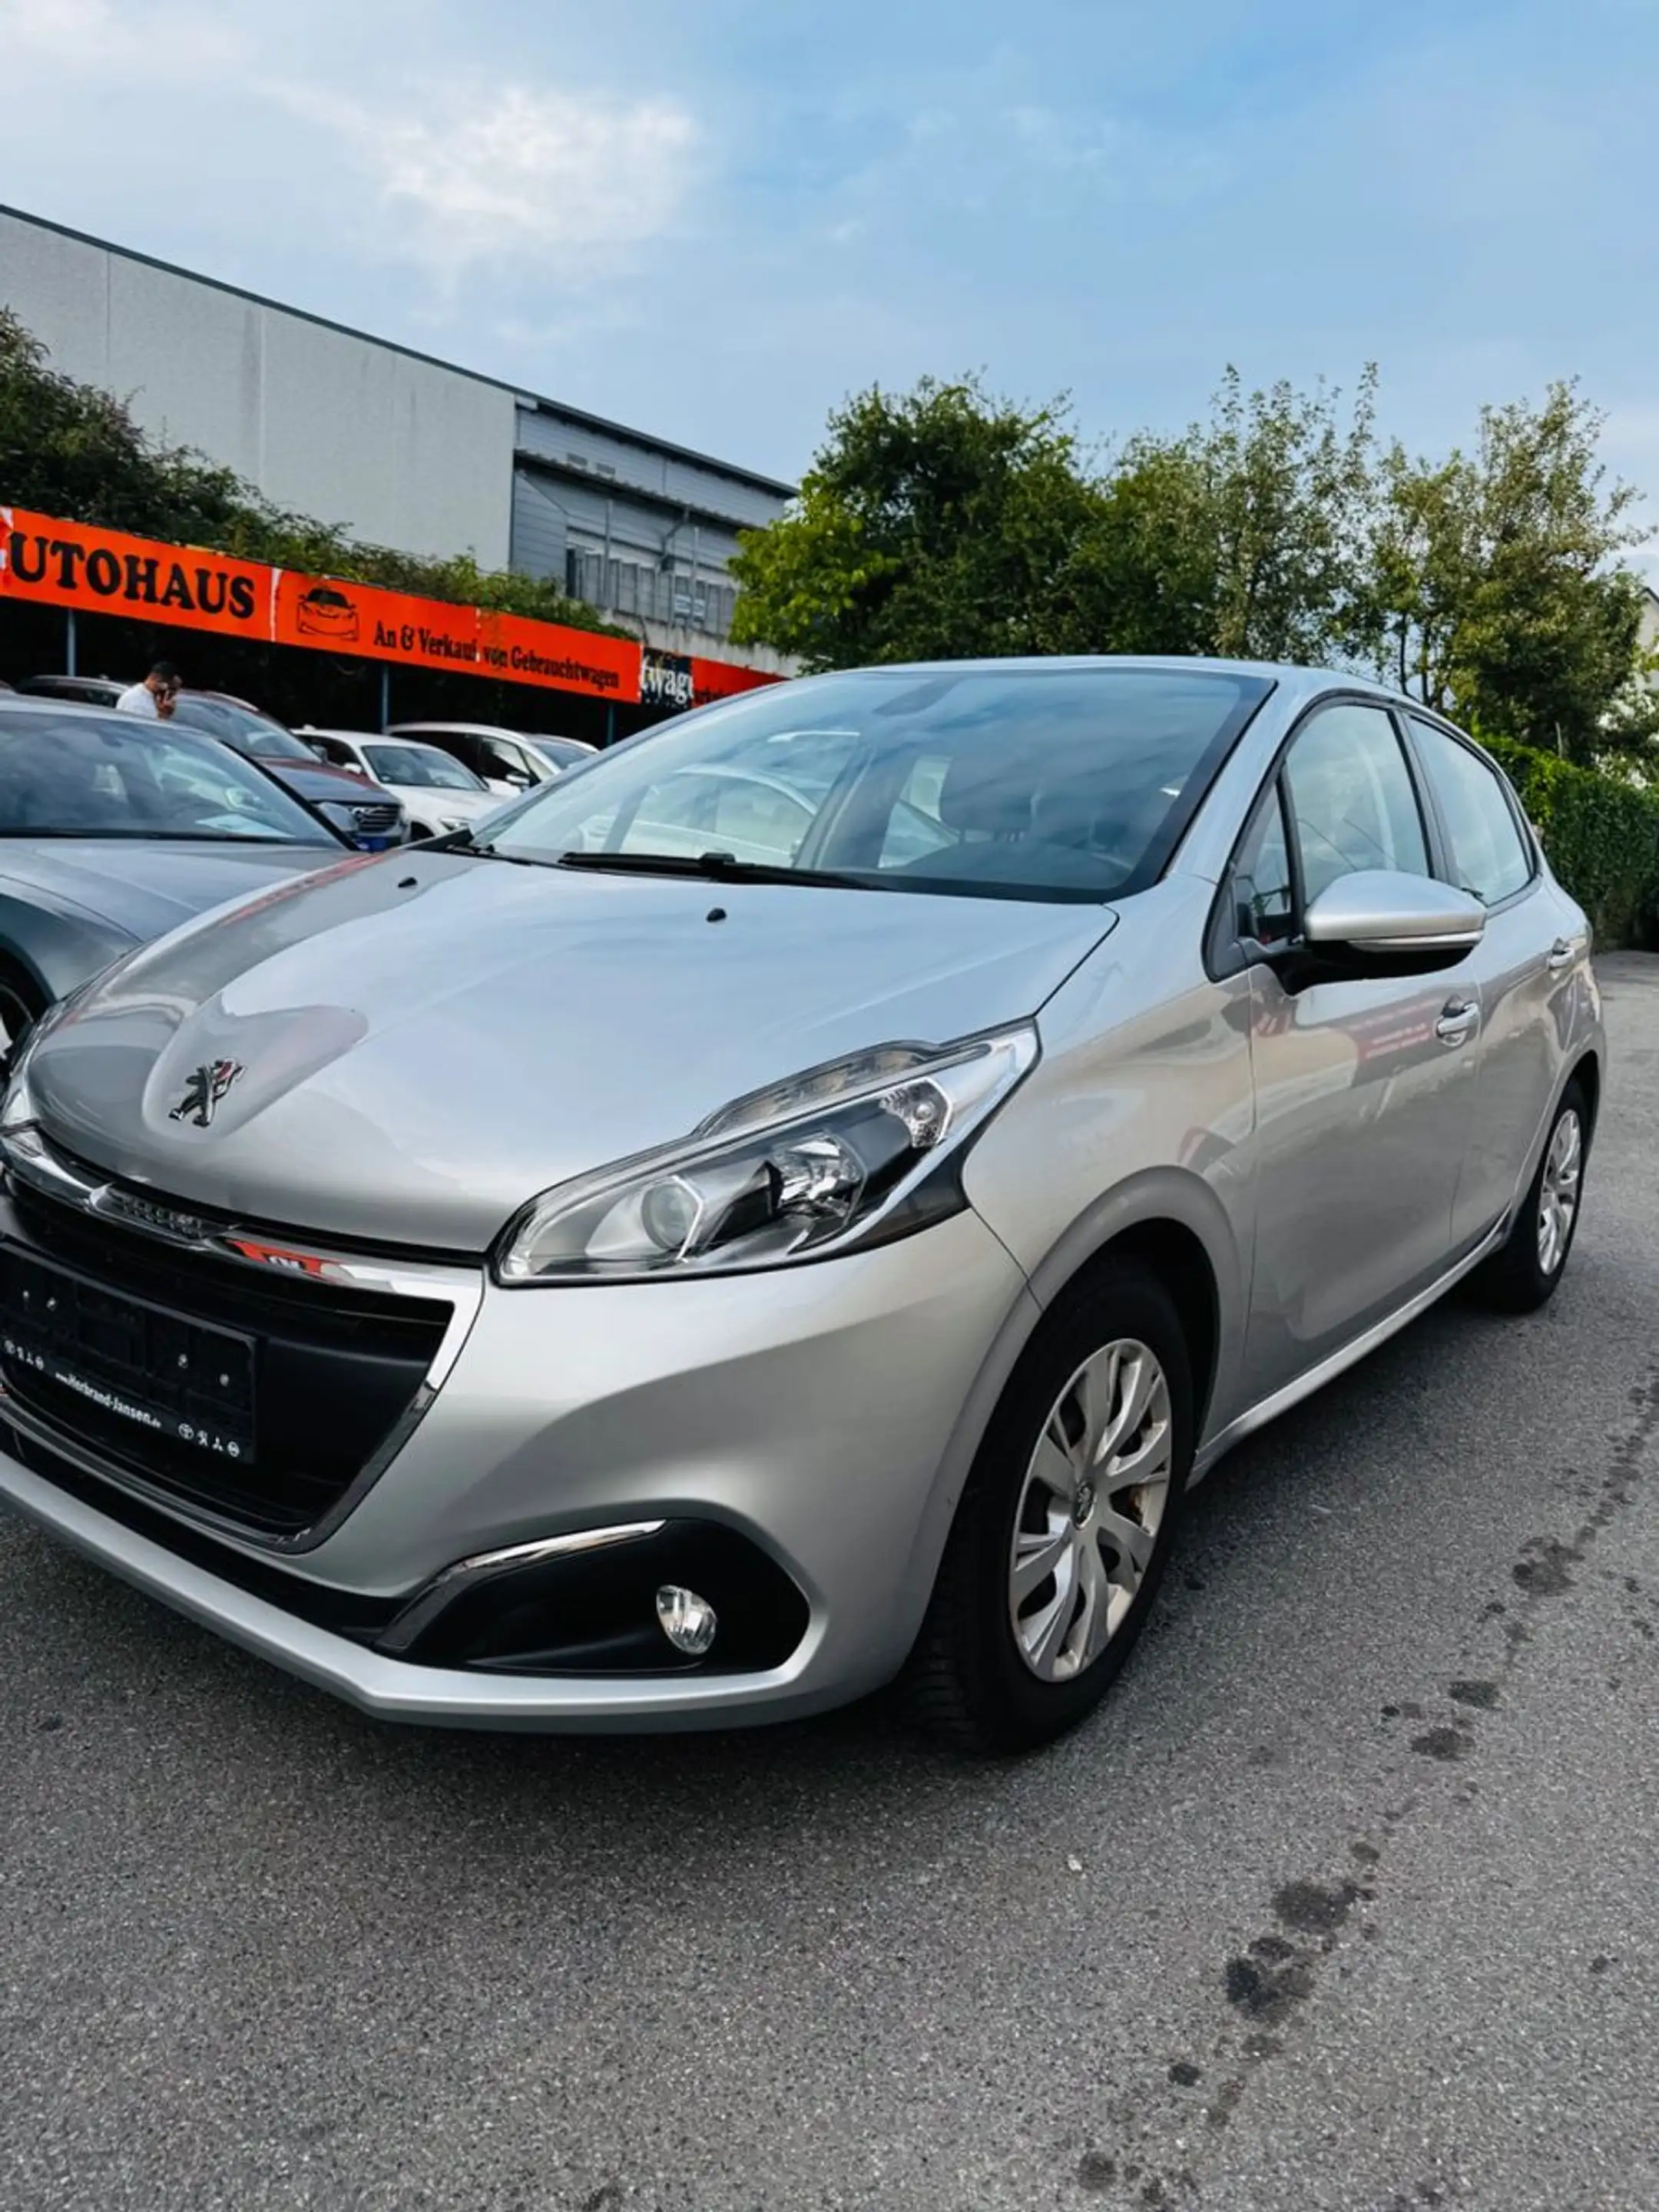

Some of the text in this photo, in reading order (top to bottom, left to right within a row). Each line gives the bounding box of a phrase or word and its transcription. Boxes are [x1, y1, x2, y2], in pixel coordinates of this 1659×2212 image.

[10, 531, 254, 619] UTOHAUS
[373, 620, 620, 693] An & Verkauf von Gebrauchtwagen
